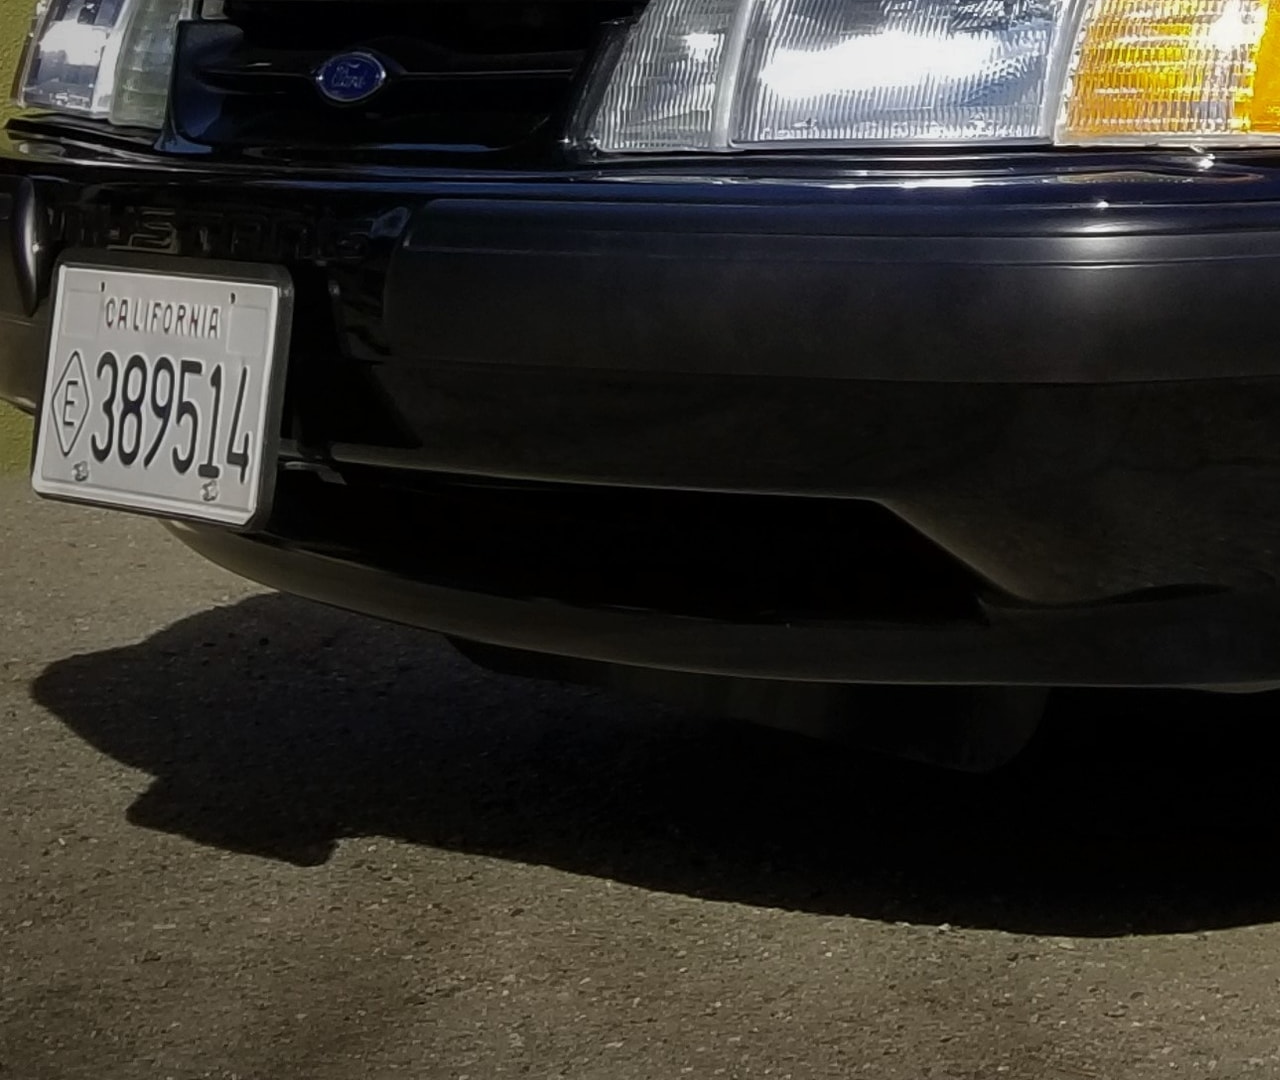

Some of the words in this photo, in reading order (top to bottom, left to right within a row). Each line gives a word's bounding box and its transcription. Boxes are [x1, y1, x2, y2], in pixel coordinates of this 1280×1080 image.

[105, 297, 222, 340] CALIFORNIA
[61, 379, 79, 426] E
[91, 351, 252, 484] 389514
